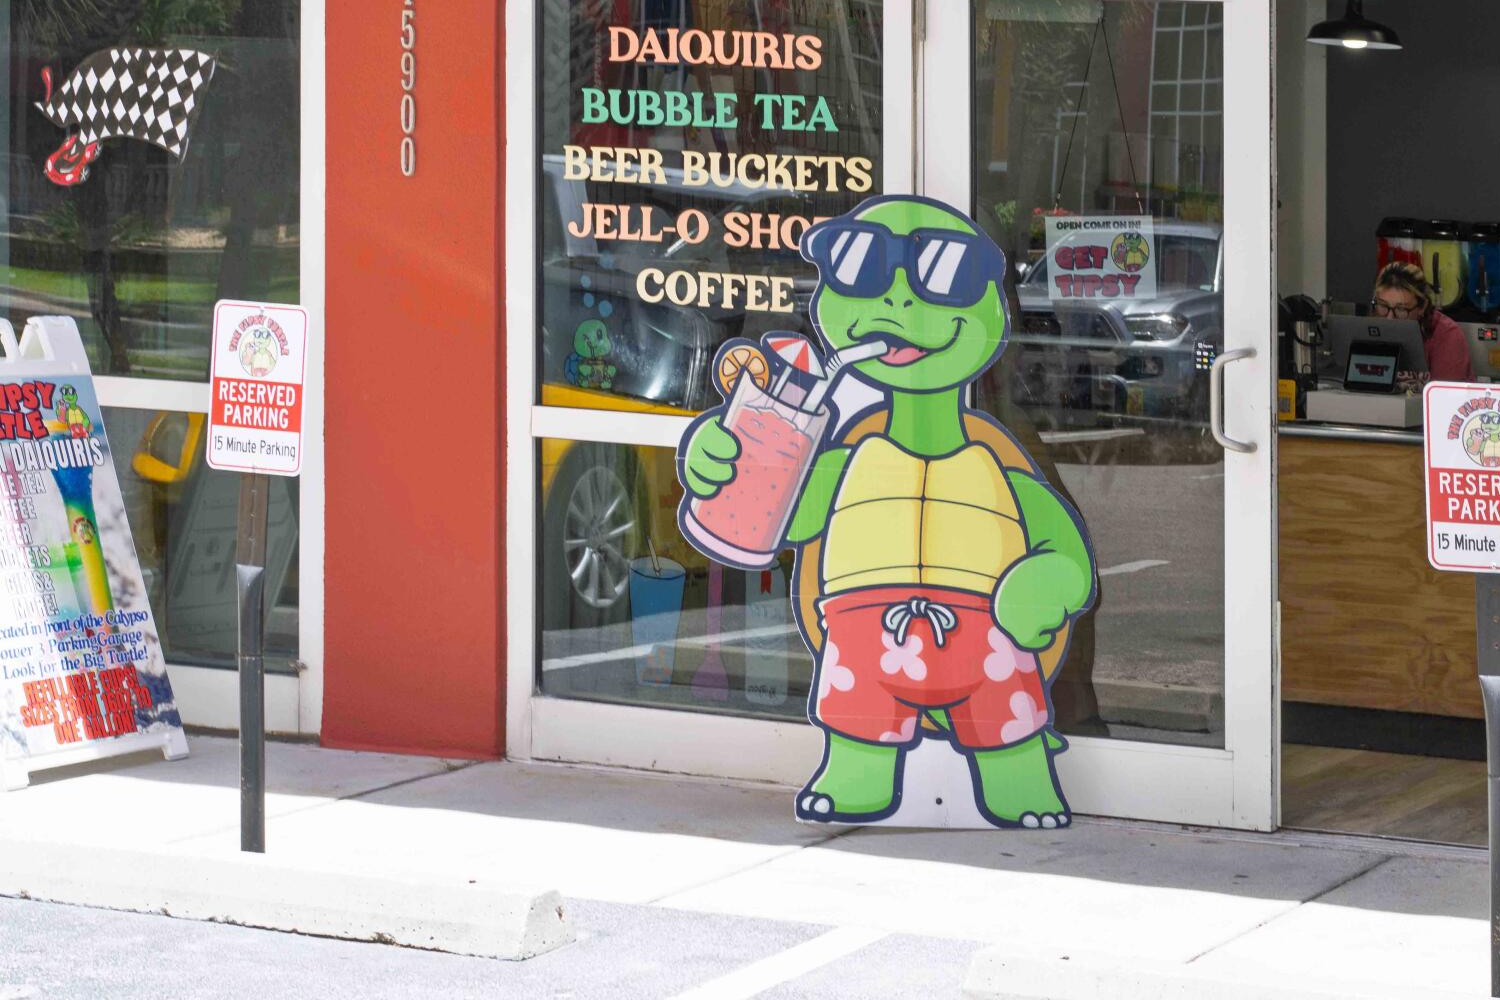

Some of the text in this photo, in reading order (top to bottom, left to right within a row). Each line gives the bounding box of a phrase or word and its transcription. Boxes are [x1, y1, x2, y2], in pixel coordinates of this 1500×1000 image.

[608, 26, 823, 71] DAIQUIRIS
[581, 87, 839, 132] BUBBLE TEA
[563, 144, 873, 193] BEER BUCKETS
[567, 202, 710, 245] JELL-O
[1056, 221, 1082, 231] OPEN
[1083, 220, 1111, 231] COME
[1112, 220, 1127, 230] ON
[1055, 245, 1109, 270] GET
[635, 267, 795, 314] COFFEE
[1054, 273, 1141, 298] TIPSY
[0, 379, 56, 411] IPSY
[218, 380, 296, 407] RESERVED
[223, 403, 290, 429] PARKING
[1447, 413, 1464, 440] THE
[1458, 396, 1497, 418] TIPSY
[9, 437, 105, 472] DAIQUIRIS
[213, 435, 296, 462] 15 Minute Parking
[17, 471, 47, 495] TEA
[1437, 532, 1450, 550] 15
[1454, 533, 1496, 553] Minute
[31, 621, 42, 636] in
[44, 617, 71, 638] front
[74, 615, 87, 633] of
[86, 612, 104, 628] the
[105, 609, 149, 627] Calypso
[0, 645, 34, 660] ower
[3, 646, 149, 680] Look for the Big Turtle!
[22, 663, 139, 705] REFILLABLE CUPS!
[20, 700, 58, 728] SIZES
[60, 692, 100, 724] FROM
[134, 685, 153, 709] TO
[54, 710, 138, 744] ONE GALLON!
